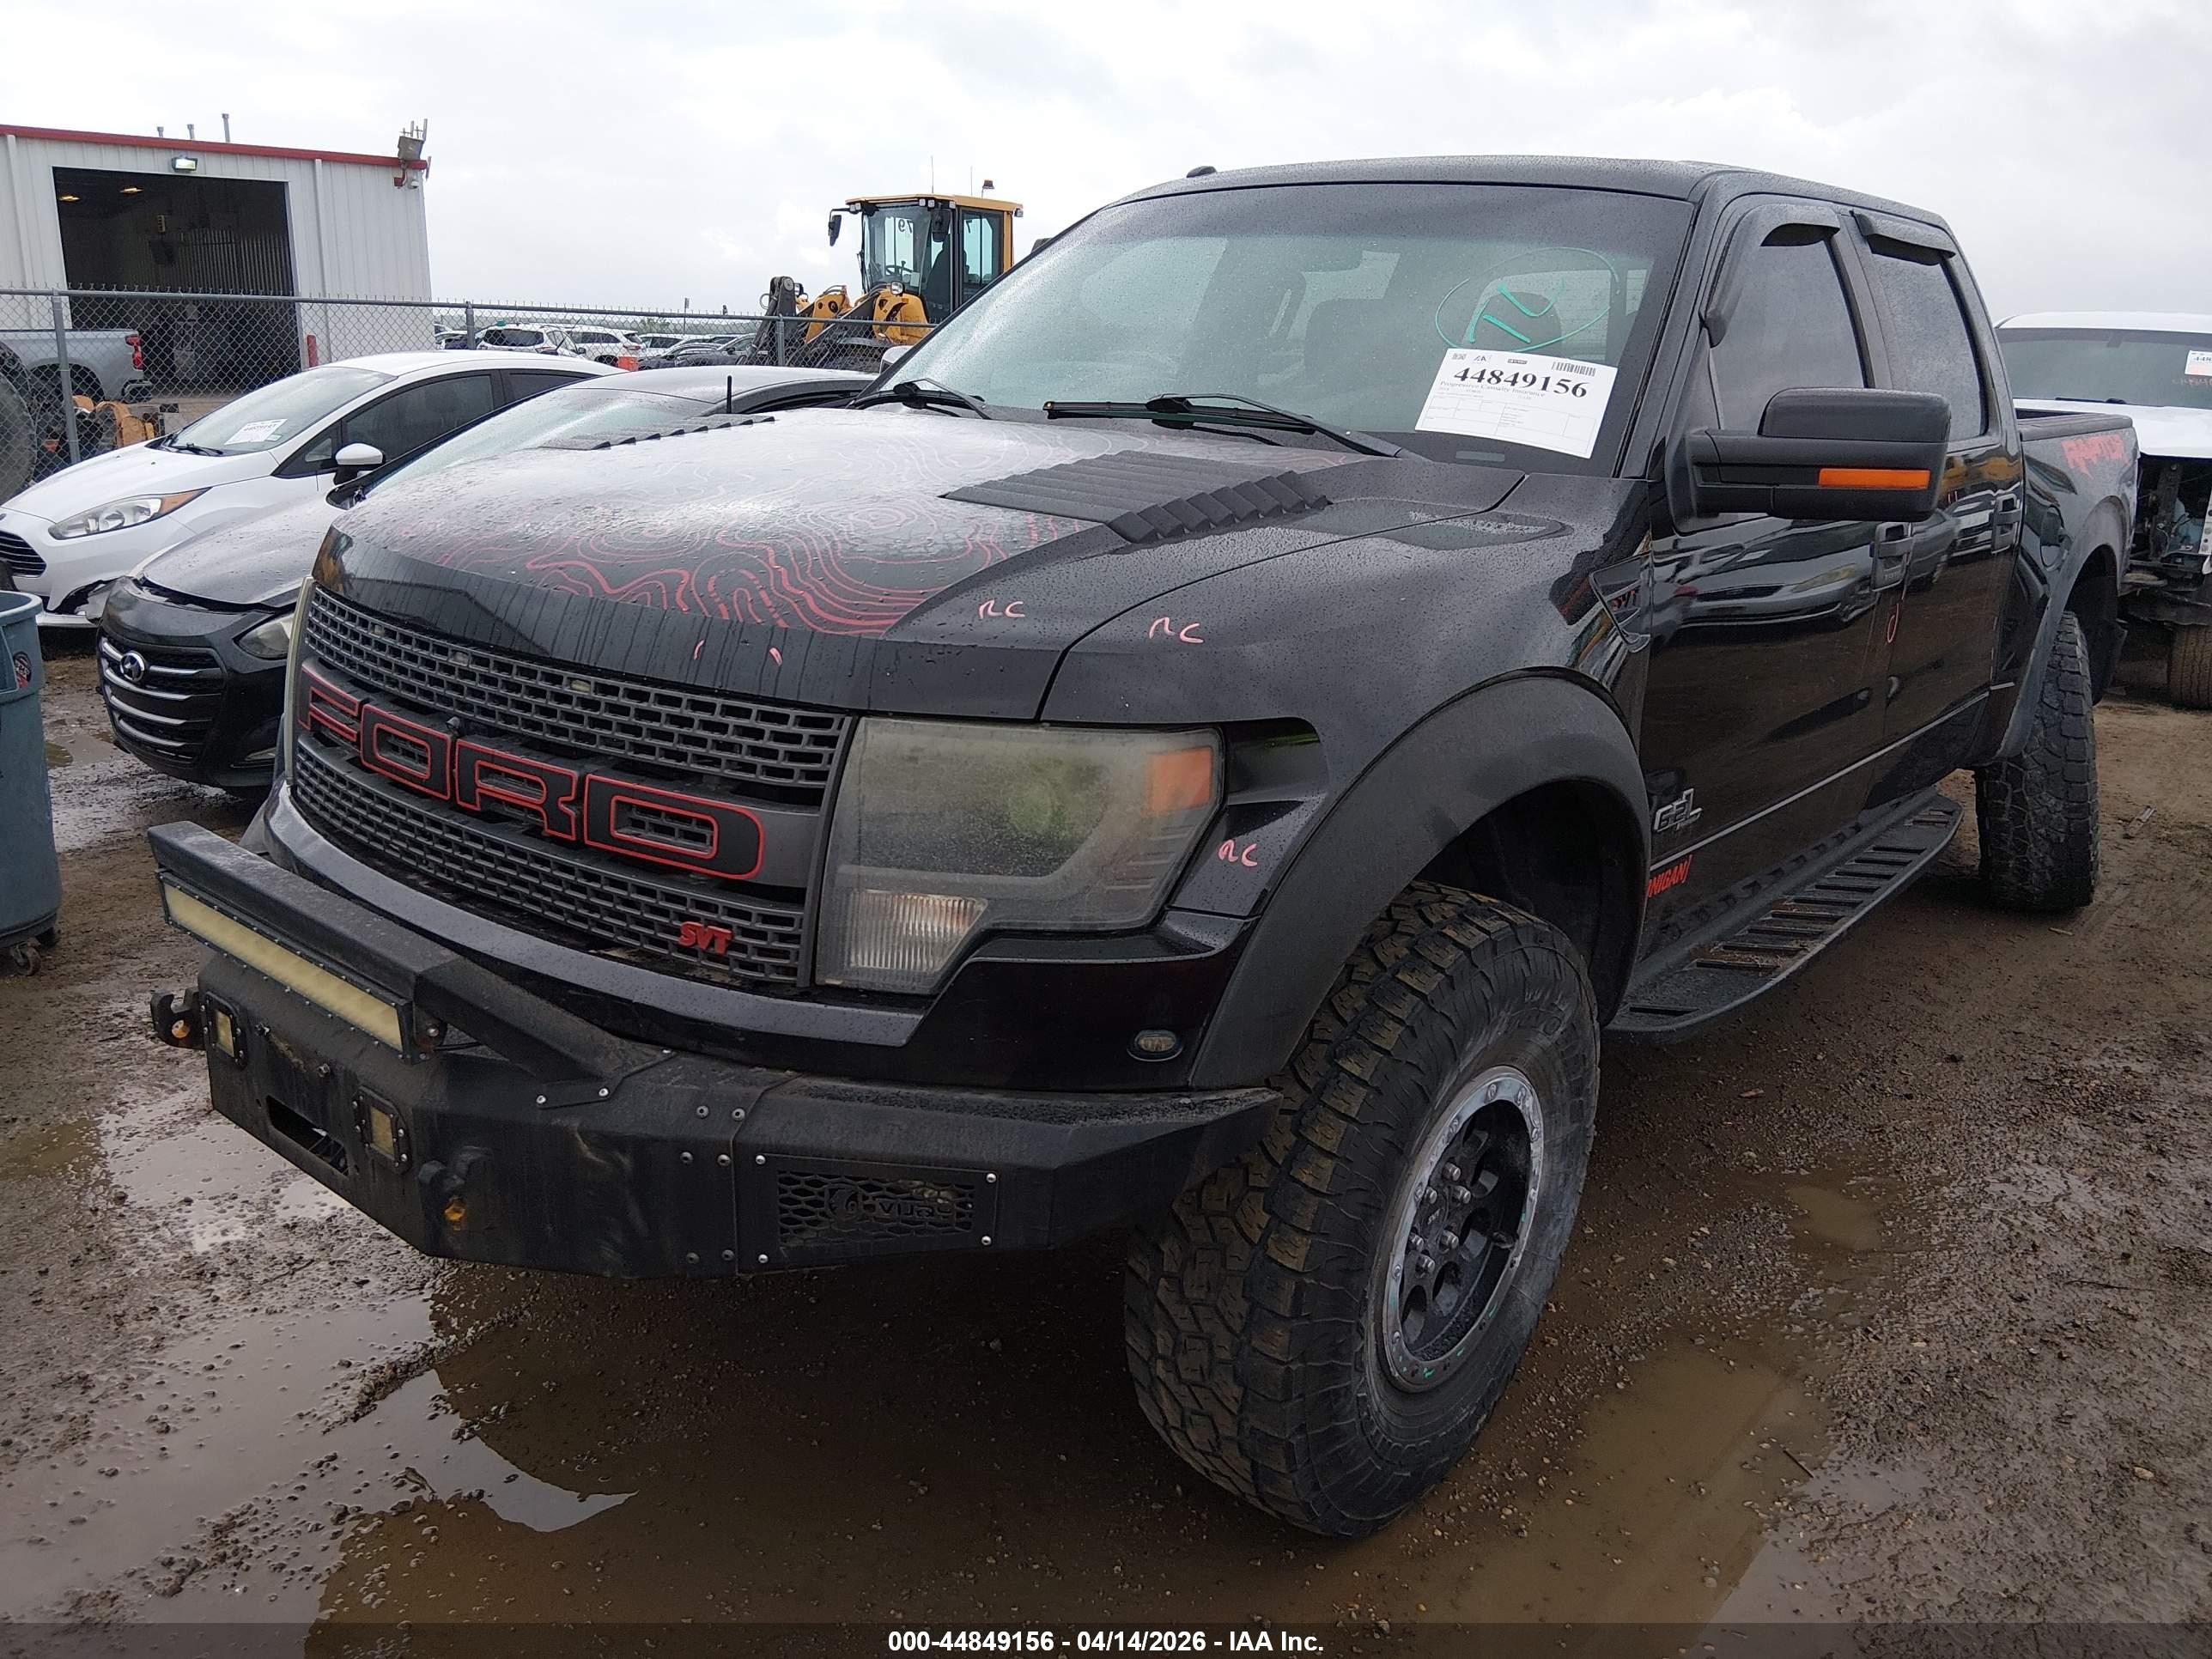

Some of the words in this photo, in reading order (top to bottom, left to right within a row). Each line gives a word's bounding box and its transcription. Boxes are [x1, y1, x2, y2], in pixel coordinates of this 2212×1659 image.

[1454, 367, 1589, 398] 44849156
[1480, 384, 1510, 392] Casualty
[1512, 388, 1547, 398] Insurance
[297, 665, 765, 880] FORD
[677, 921, 734, 956] SVT
